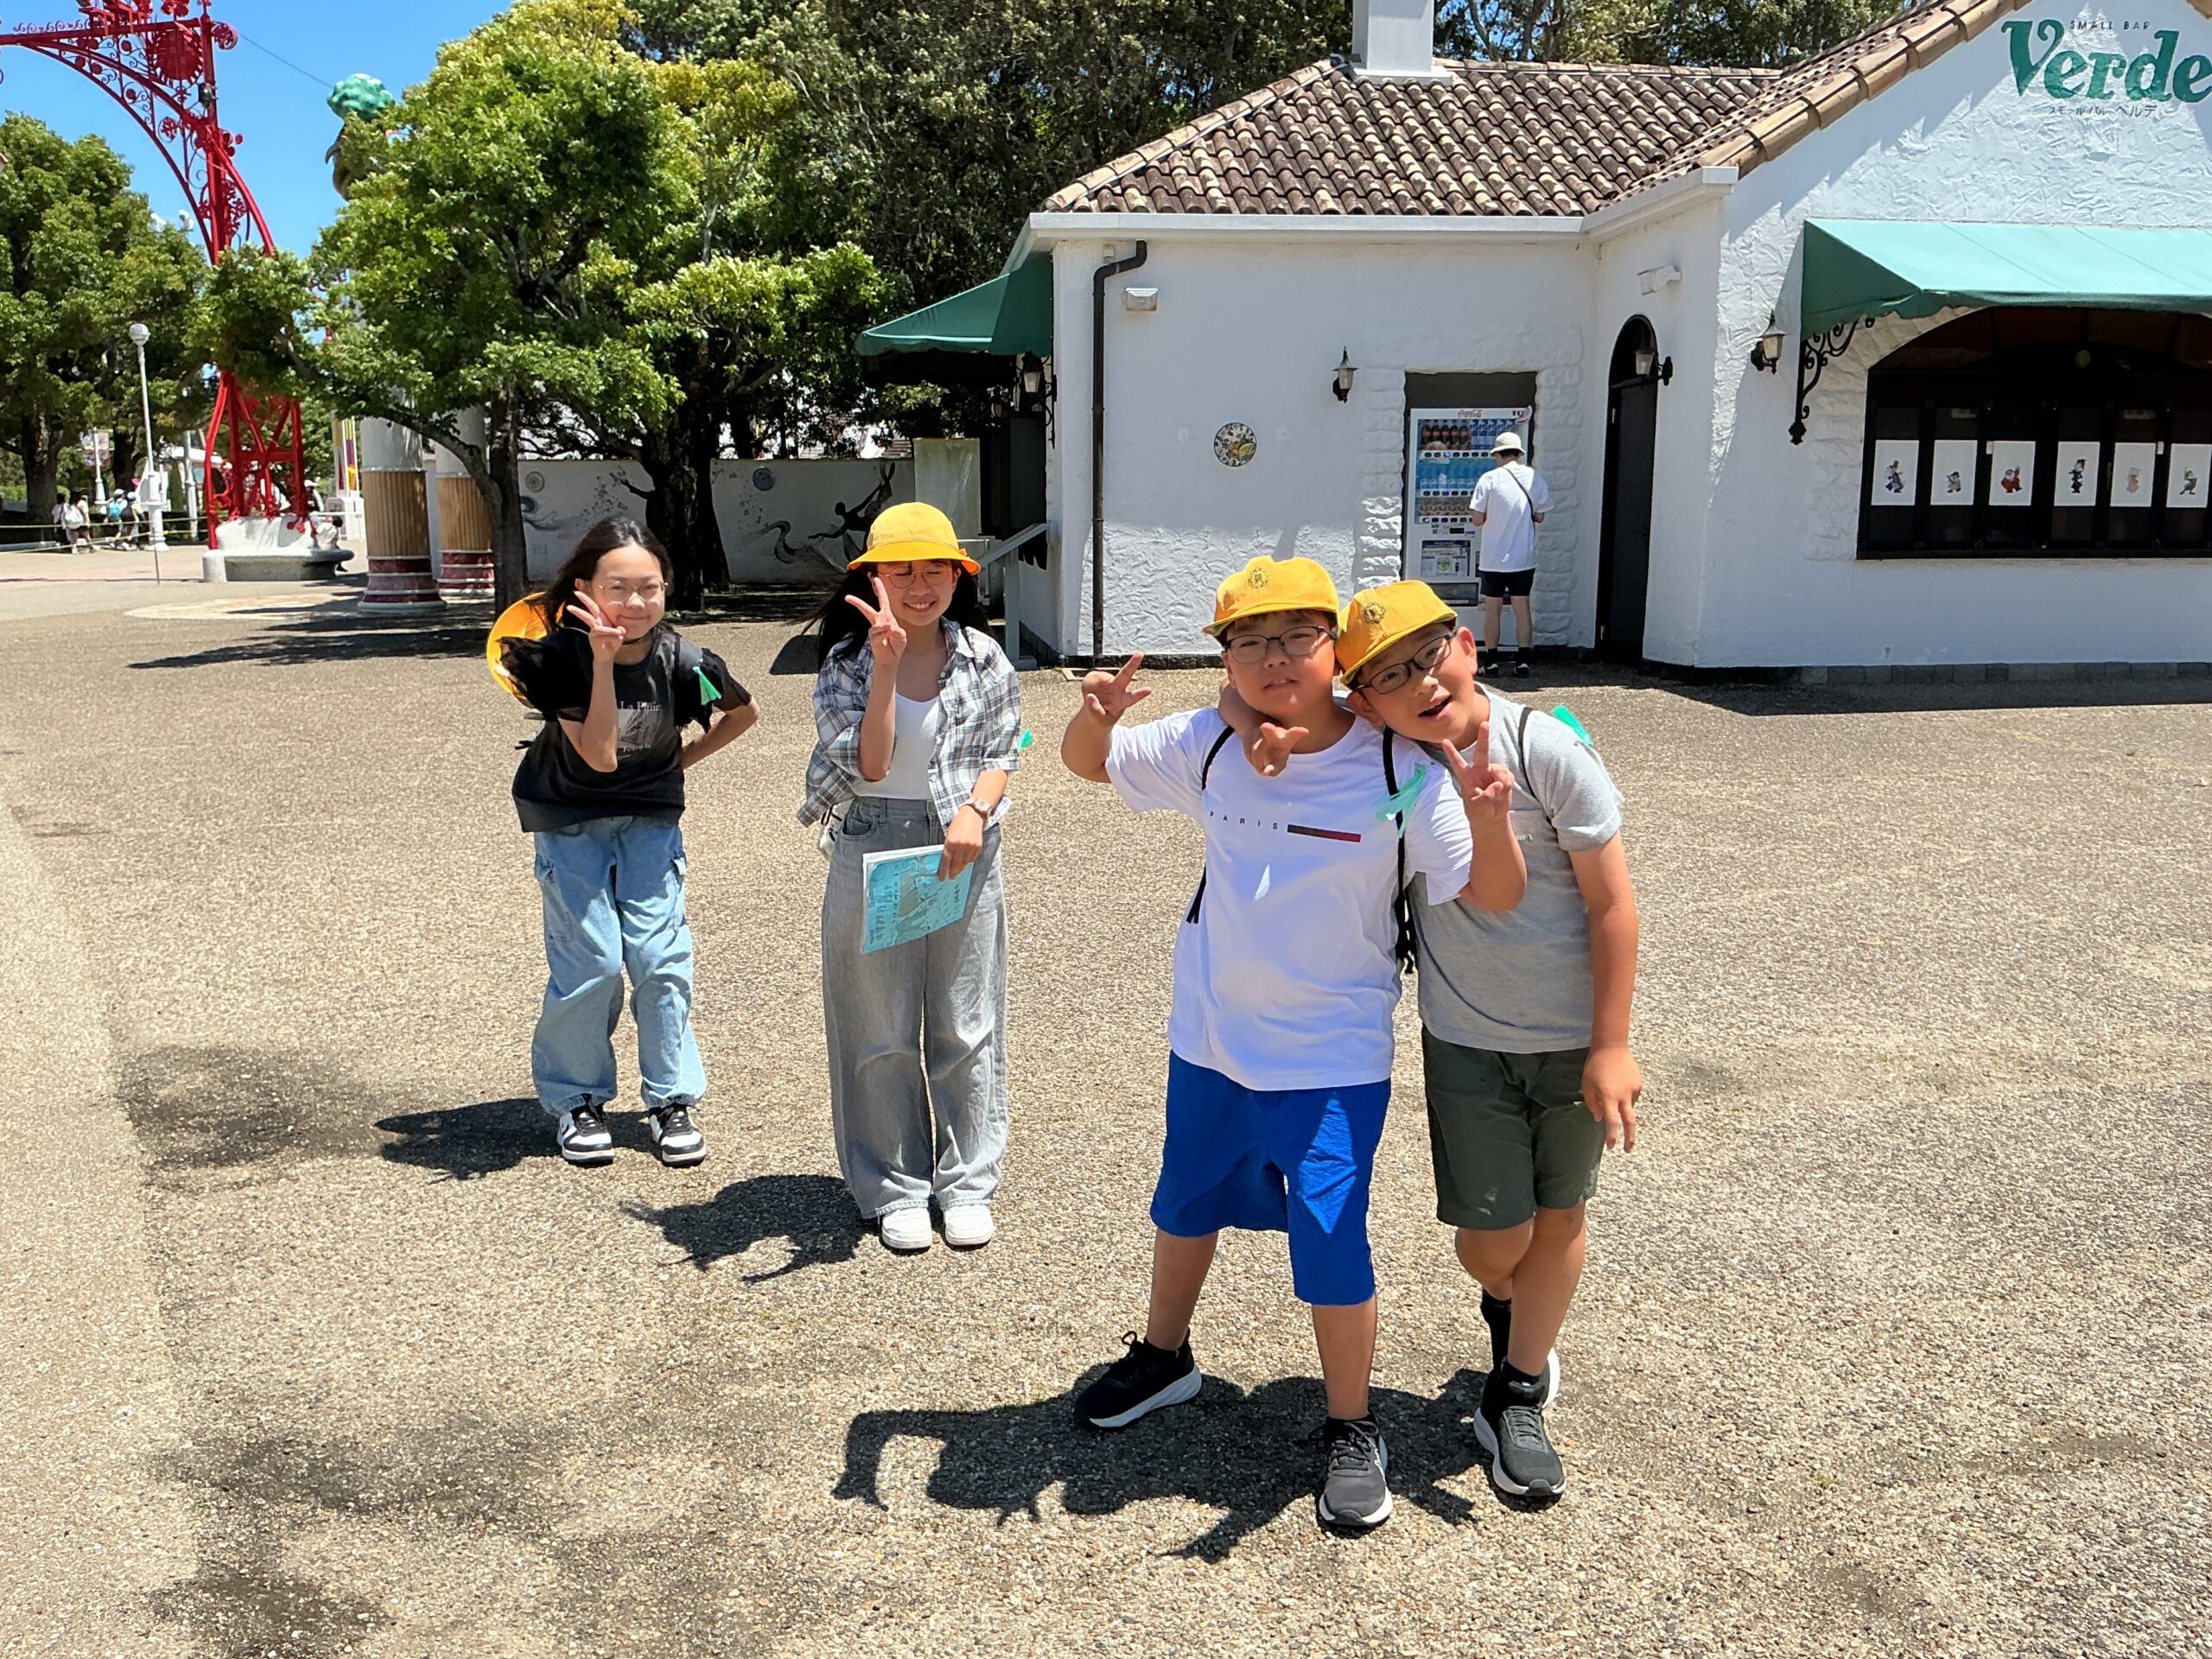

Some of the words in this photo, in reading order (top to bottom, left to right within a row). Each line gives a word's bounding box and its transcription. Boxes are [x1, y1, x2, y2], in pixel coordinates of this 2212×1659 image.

[2070, 20, 2113, 30] SMALL
[2124, 21, 2150, 30] BAR
[2001, 19, 2212, 103] Verde
[1210, 810, 1278, 830] PARIS
